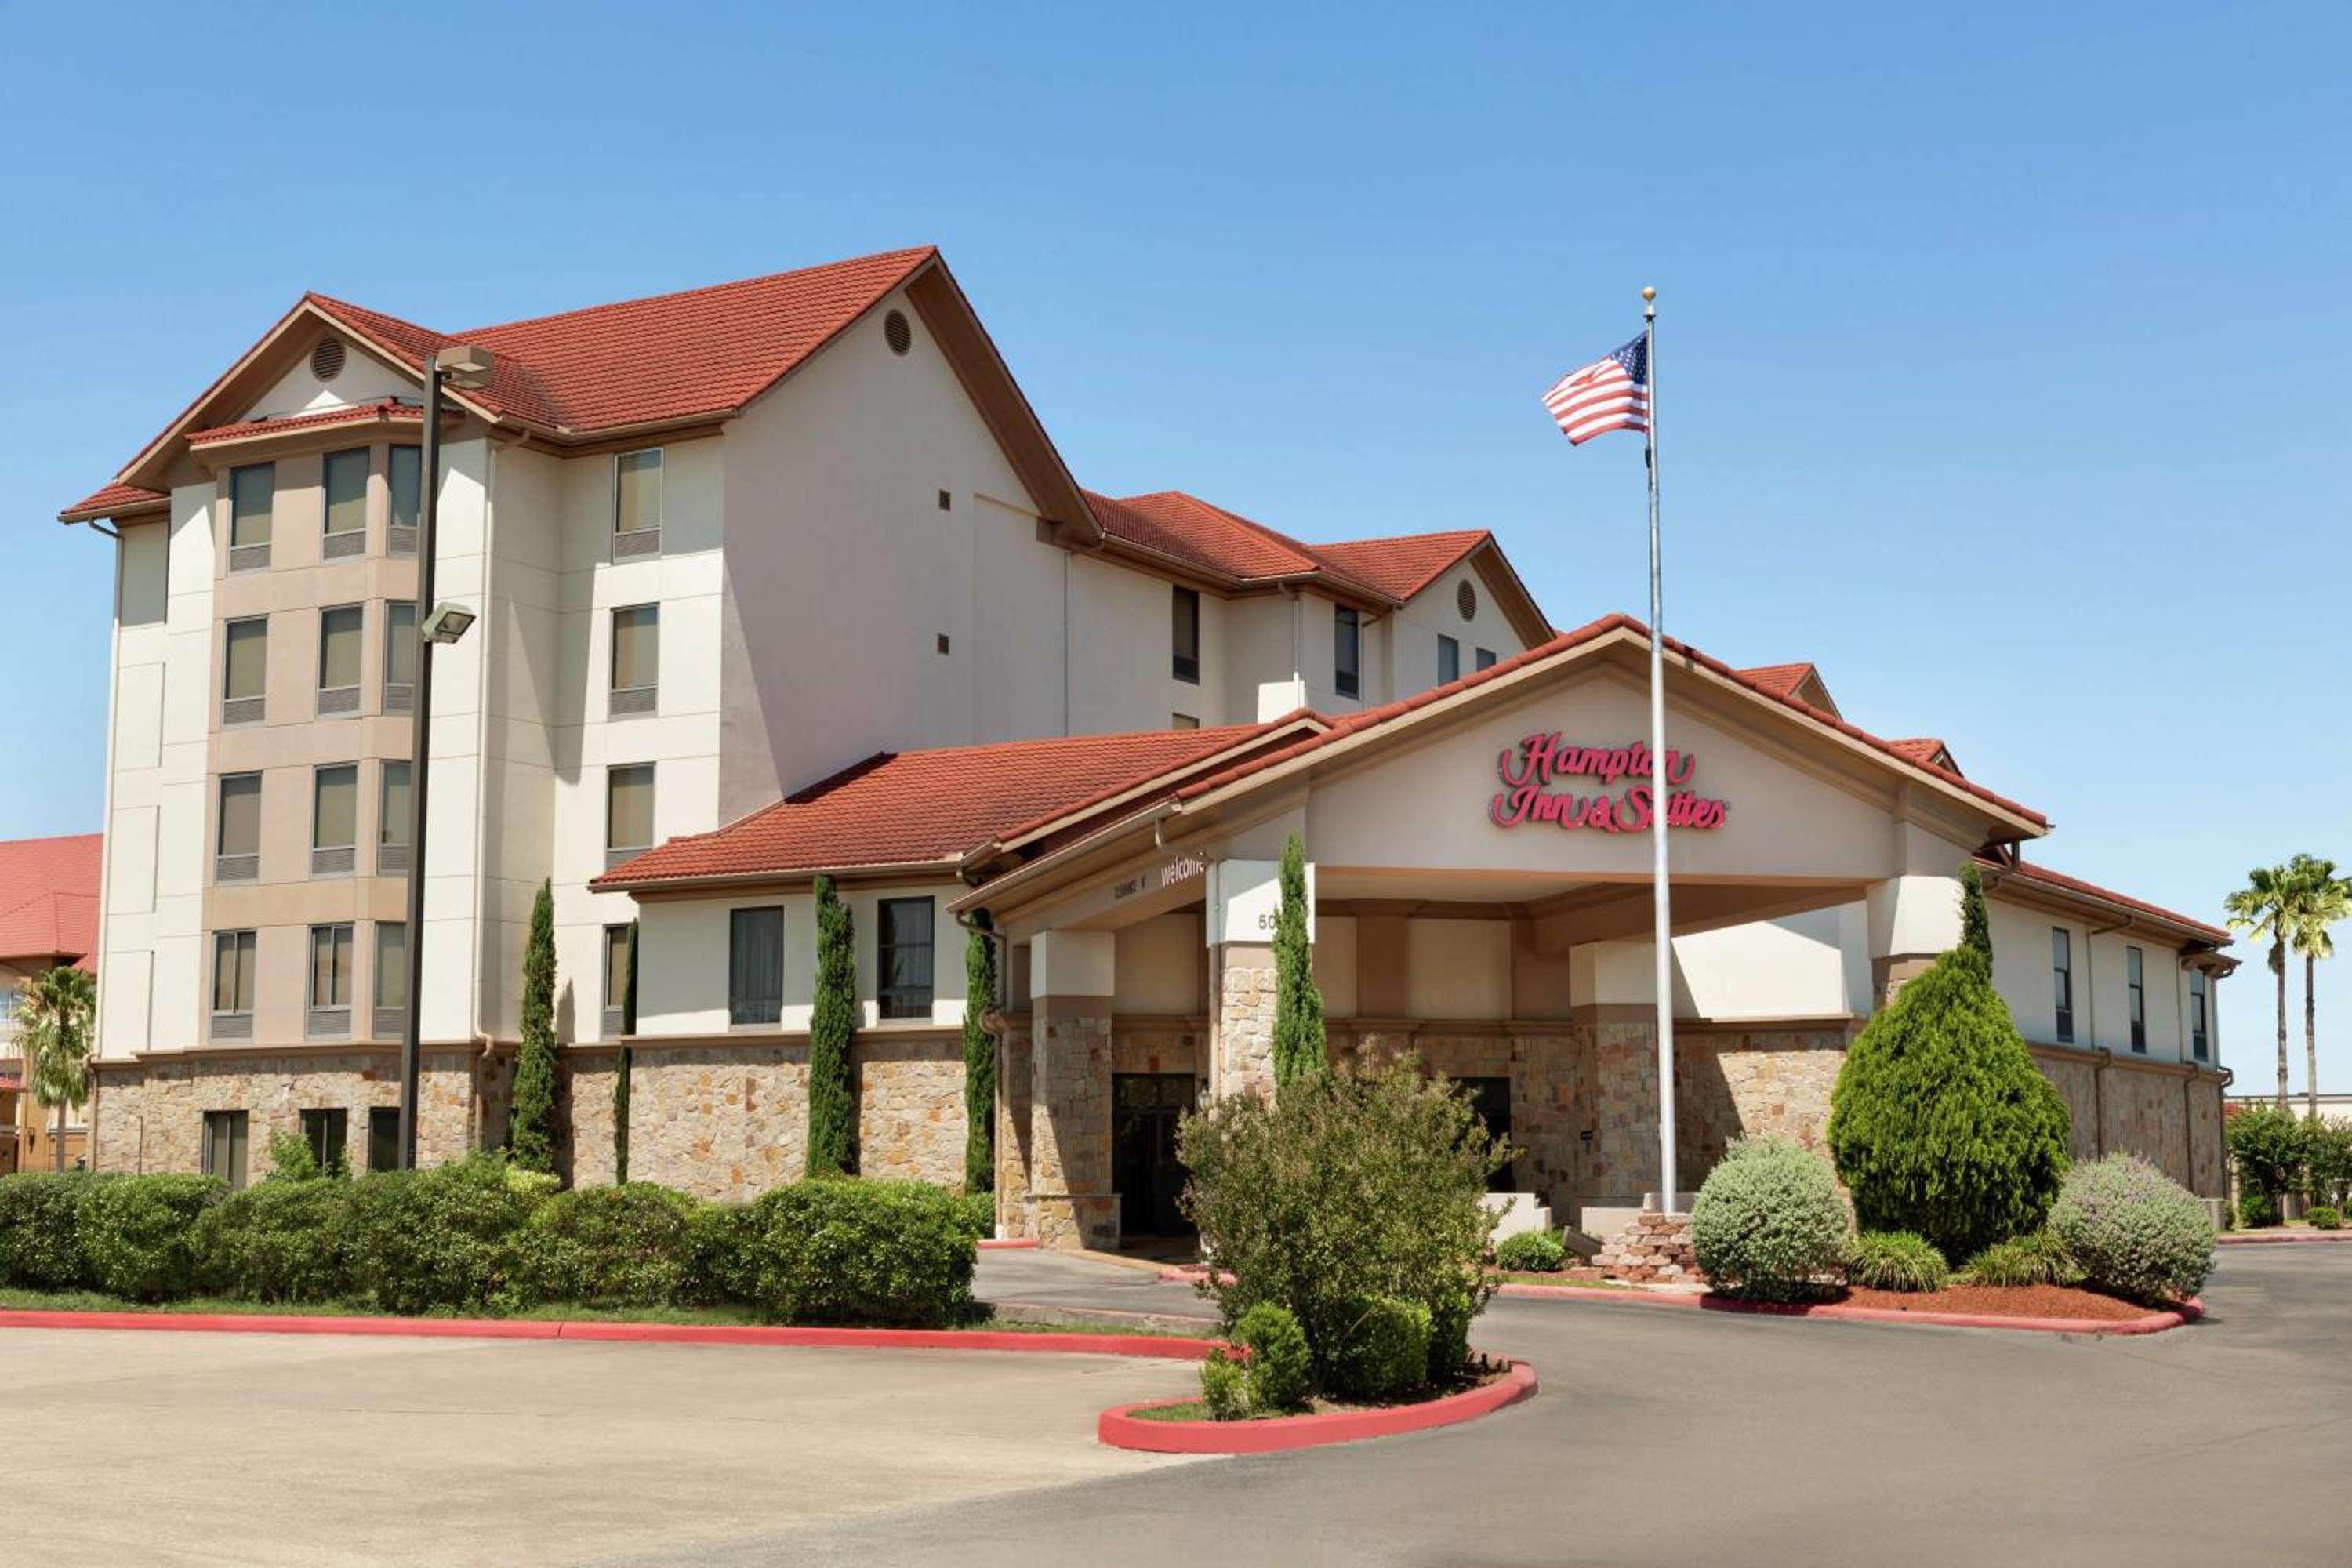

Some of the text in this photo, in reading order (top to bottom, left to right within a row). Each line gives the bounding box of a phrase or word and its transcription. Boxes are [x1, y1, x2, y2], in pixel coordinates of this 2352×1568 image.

[1499, 731, 1695, 786] Hampton
[1490, 784, 1589, 829] Inn
[1588, 795, 1619, 834] &
[1161, 854, 1204, 887] welcome
